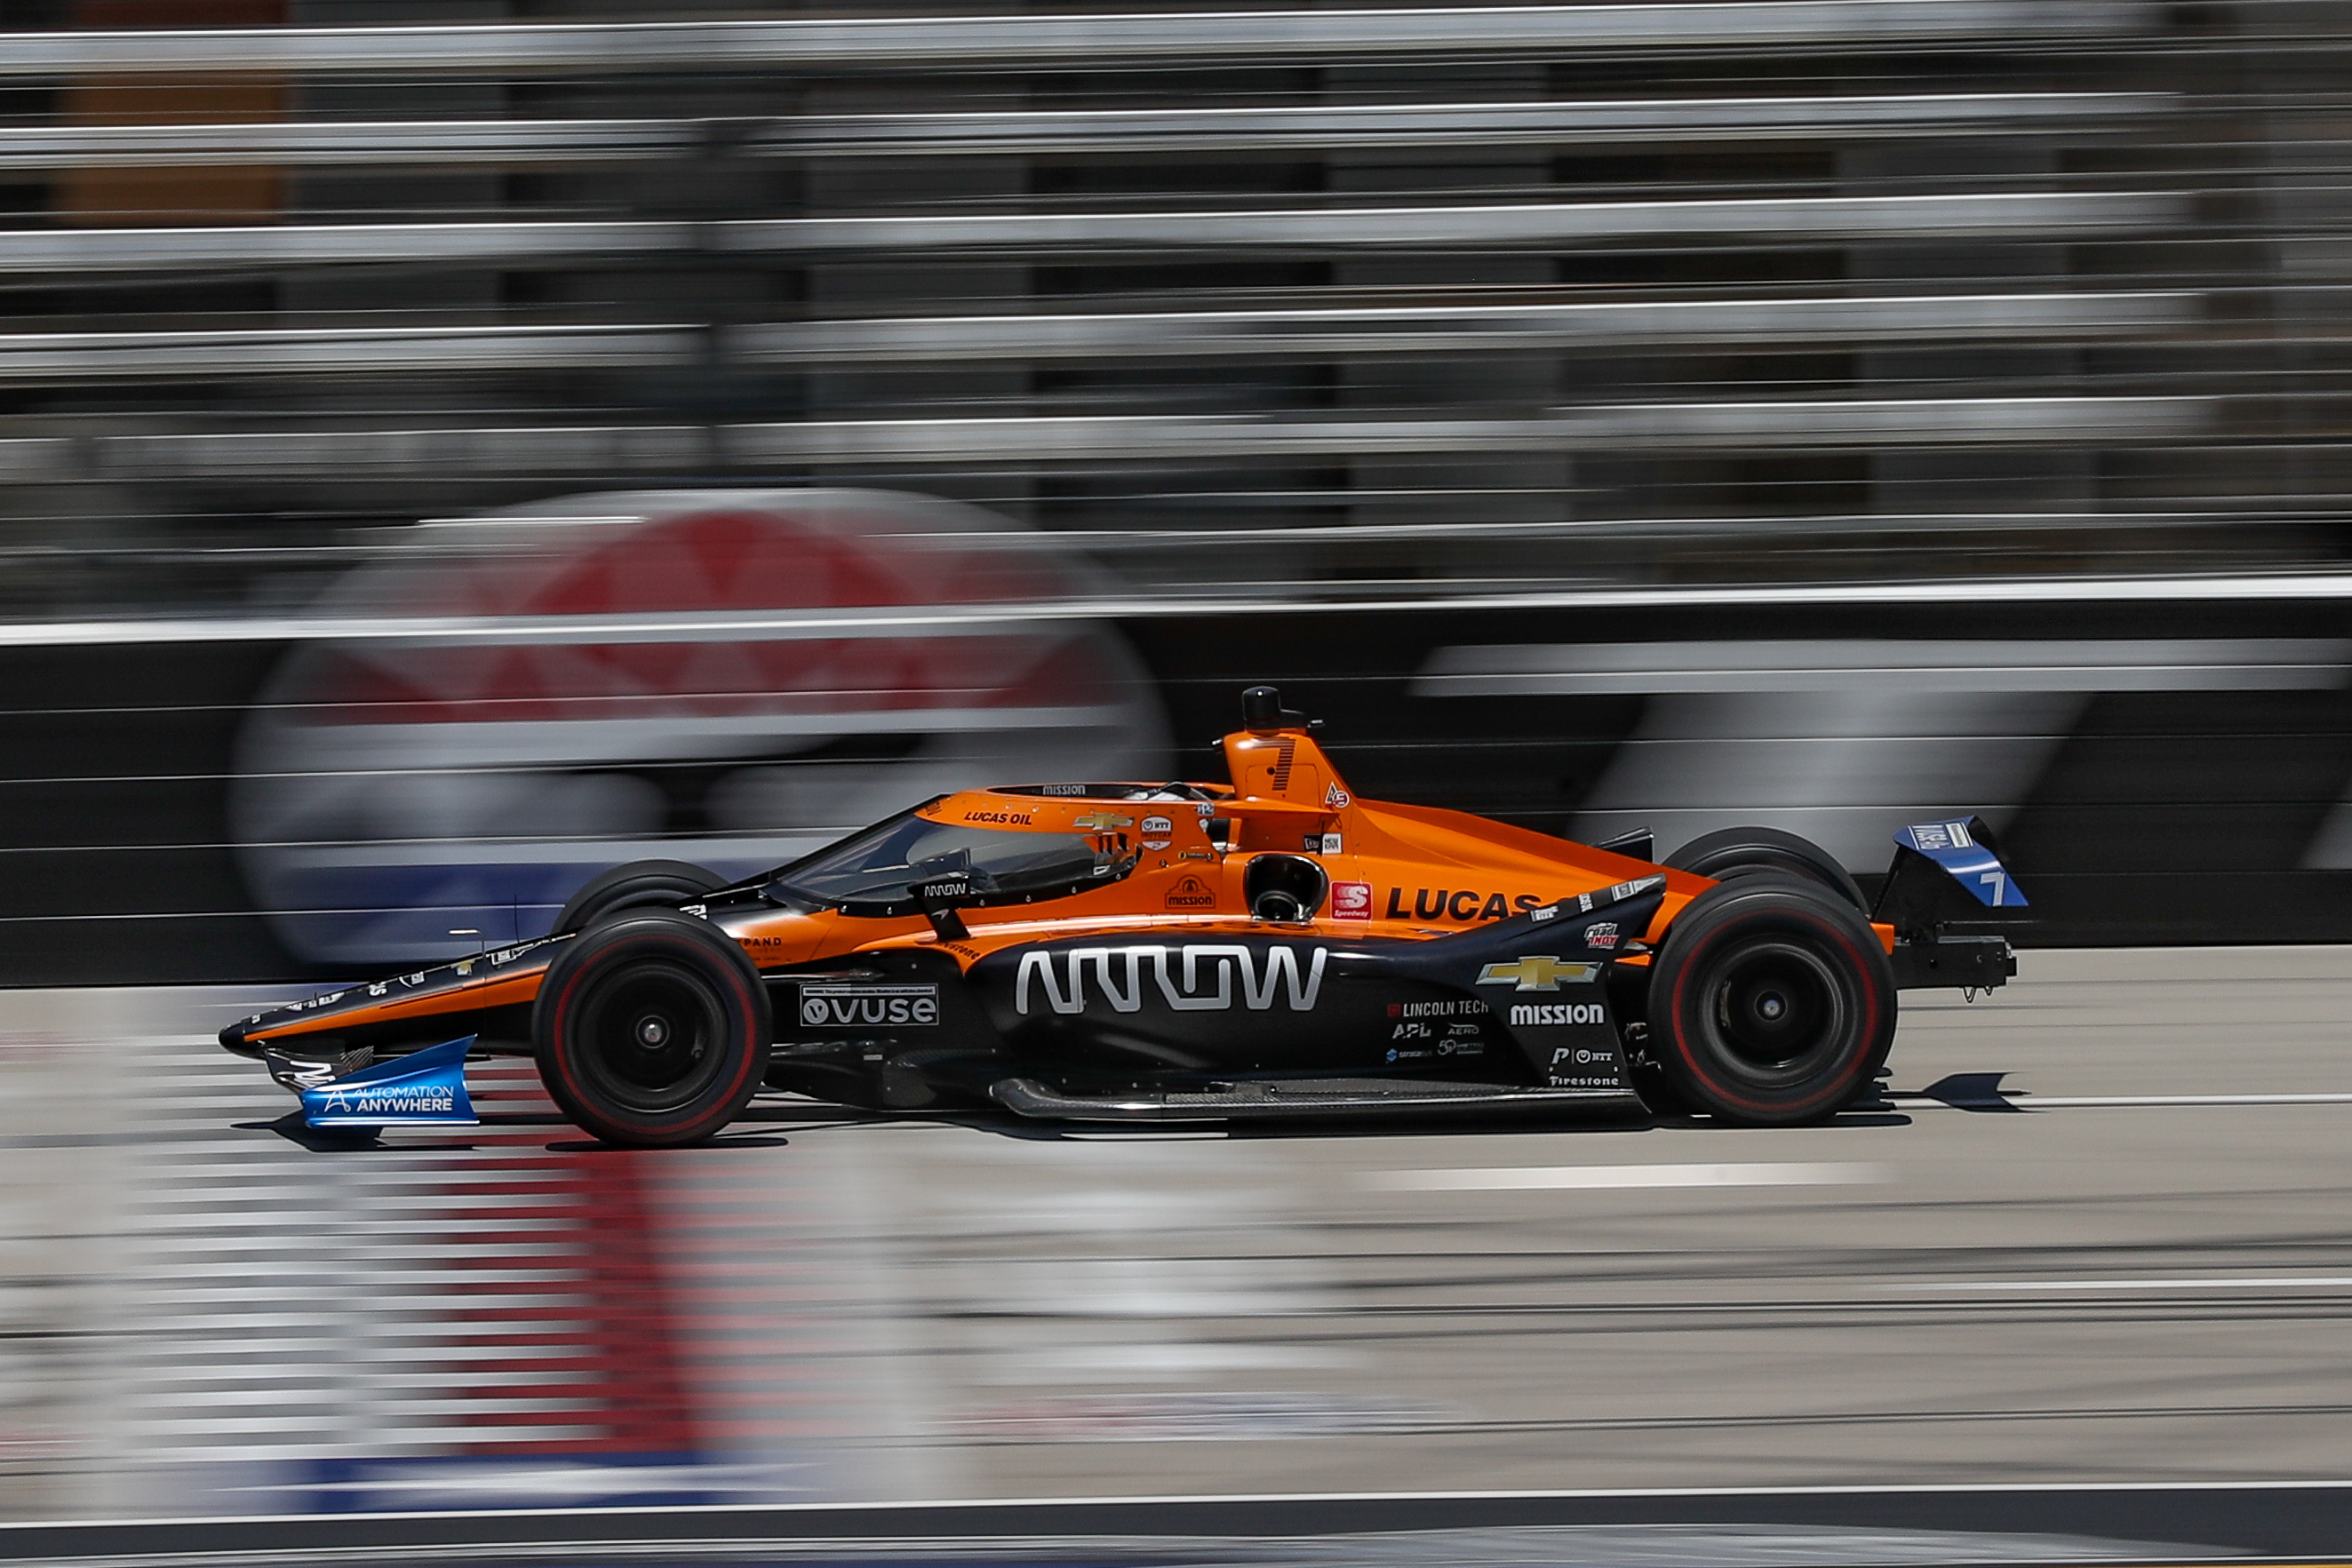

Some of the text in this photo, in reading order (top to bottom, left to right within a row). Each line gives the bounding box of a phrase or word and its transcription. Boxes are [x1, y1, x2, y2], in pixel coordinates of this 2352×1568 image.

[964, 811, 1032, 825] LUCAS OIL
[1980, 872, 2005, 907] 7
[1334, 909, 1369, 918] Speedway
[1589, 935, 1619, 945] INDY
[1403, 1001, 1455, 1018] LINCOLN
[1591, 1052, 1614, 1062] NTT
[1549, 1075, 1619, 1086] Firestone
[353, 1085, 455, 1099] AUTOMATION
[356, 1097, 453, 1112] ANYWHERE
